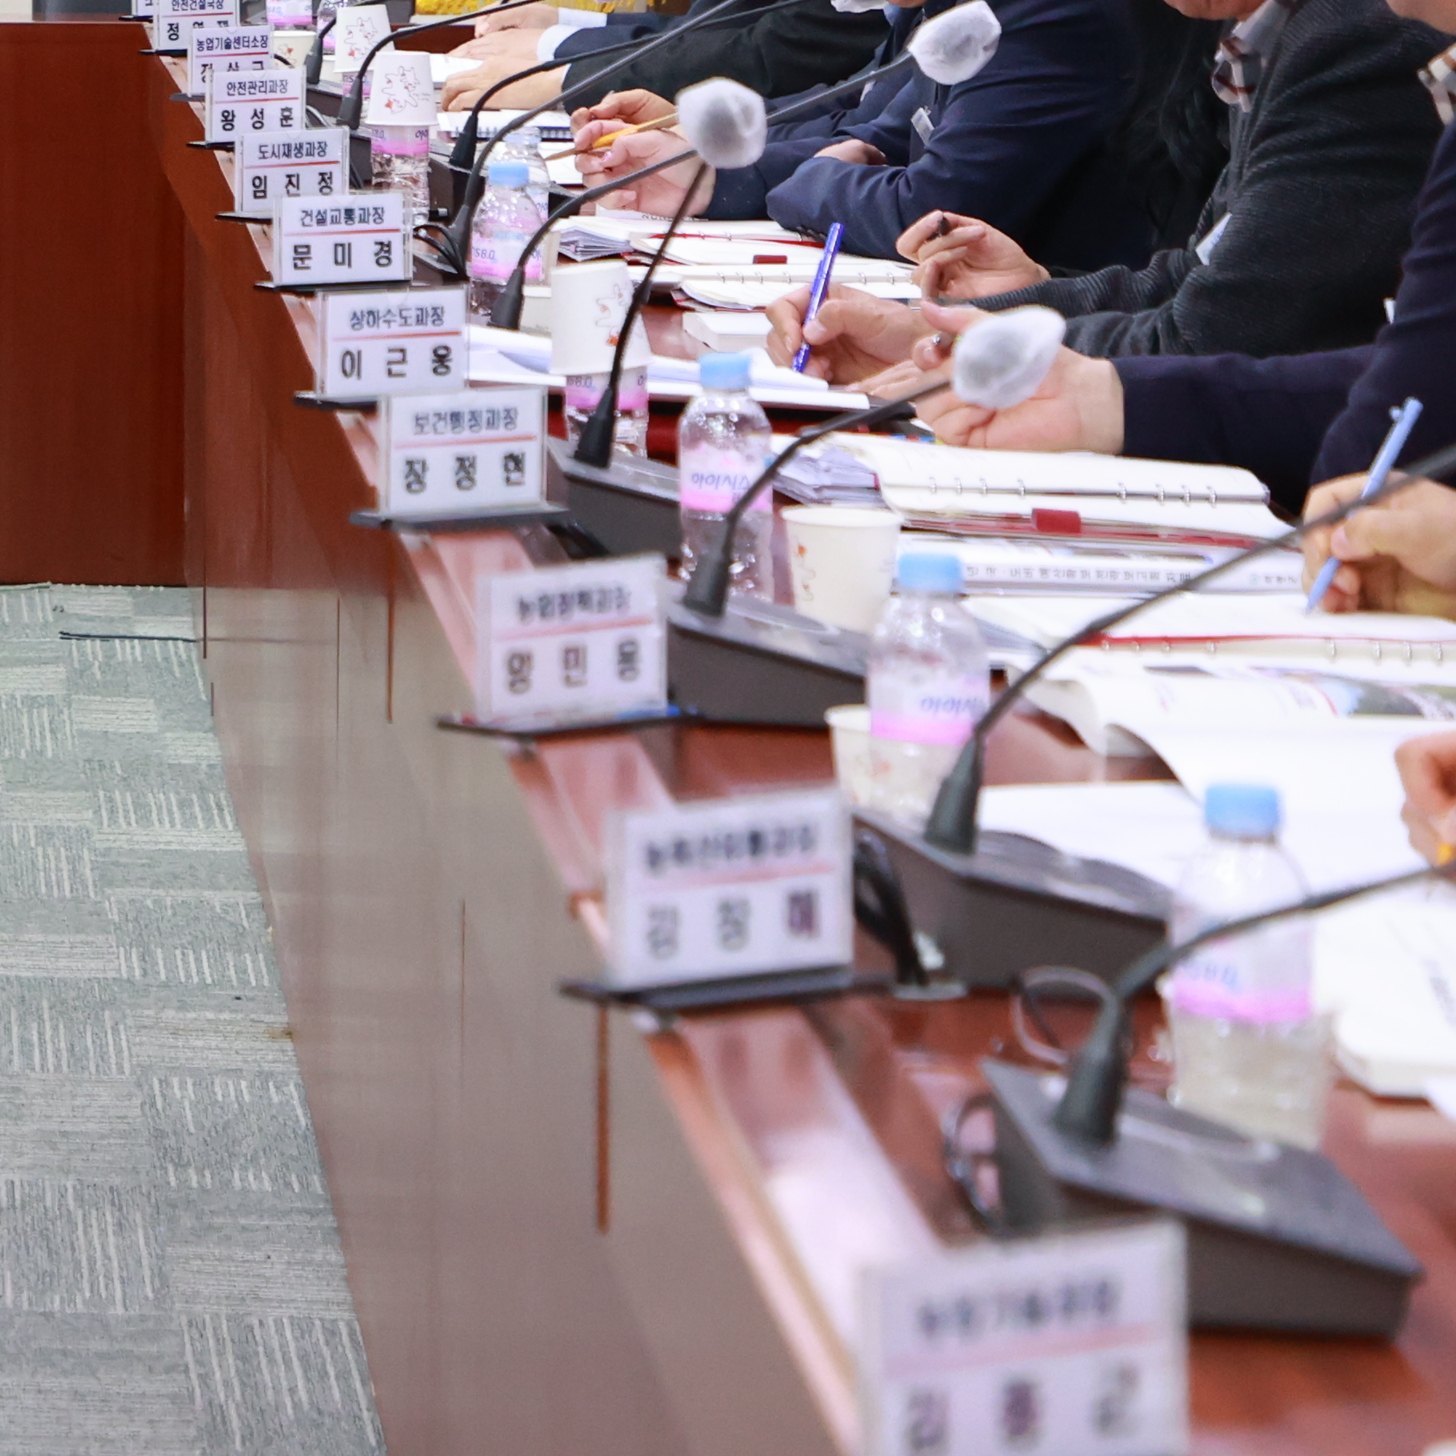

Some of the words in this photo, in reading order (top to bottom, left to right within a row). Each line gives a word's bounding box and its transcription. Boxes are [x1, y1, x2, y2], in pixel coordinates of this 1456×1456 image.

[197, 34, 269, 52] 농업기술센터소장
[226, 79, 289, 97] 안전관리과장
[258, 140, 328, 160] 도시재생과장
[300, 206, 385, 227] 건설교통과장
[350, 305, 445, 332] 상하수도과장
[414, 406, 519, 436] 보건행정과장
